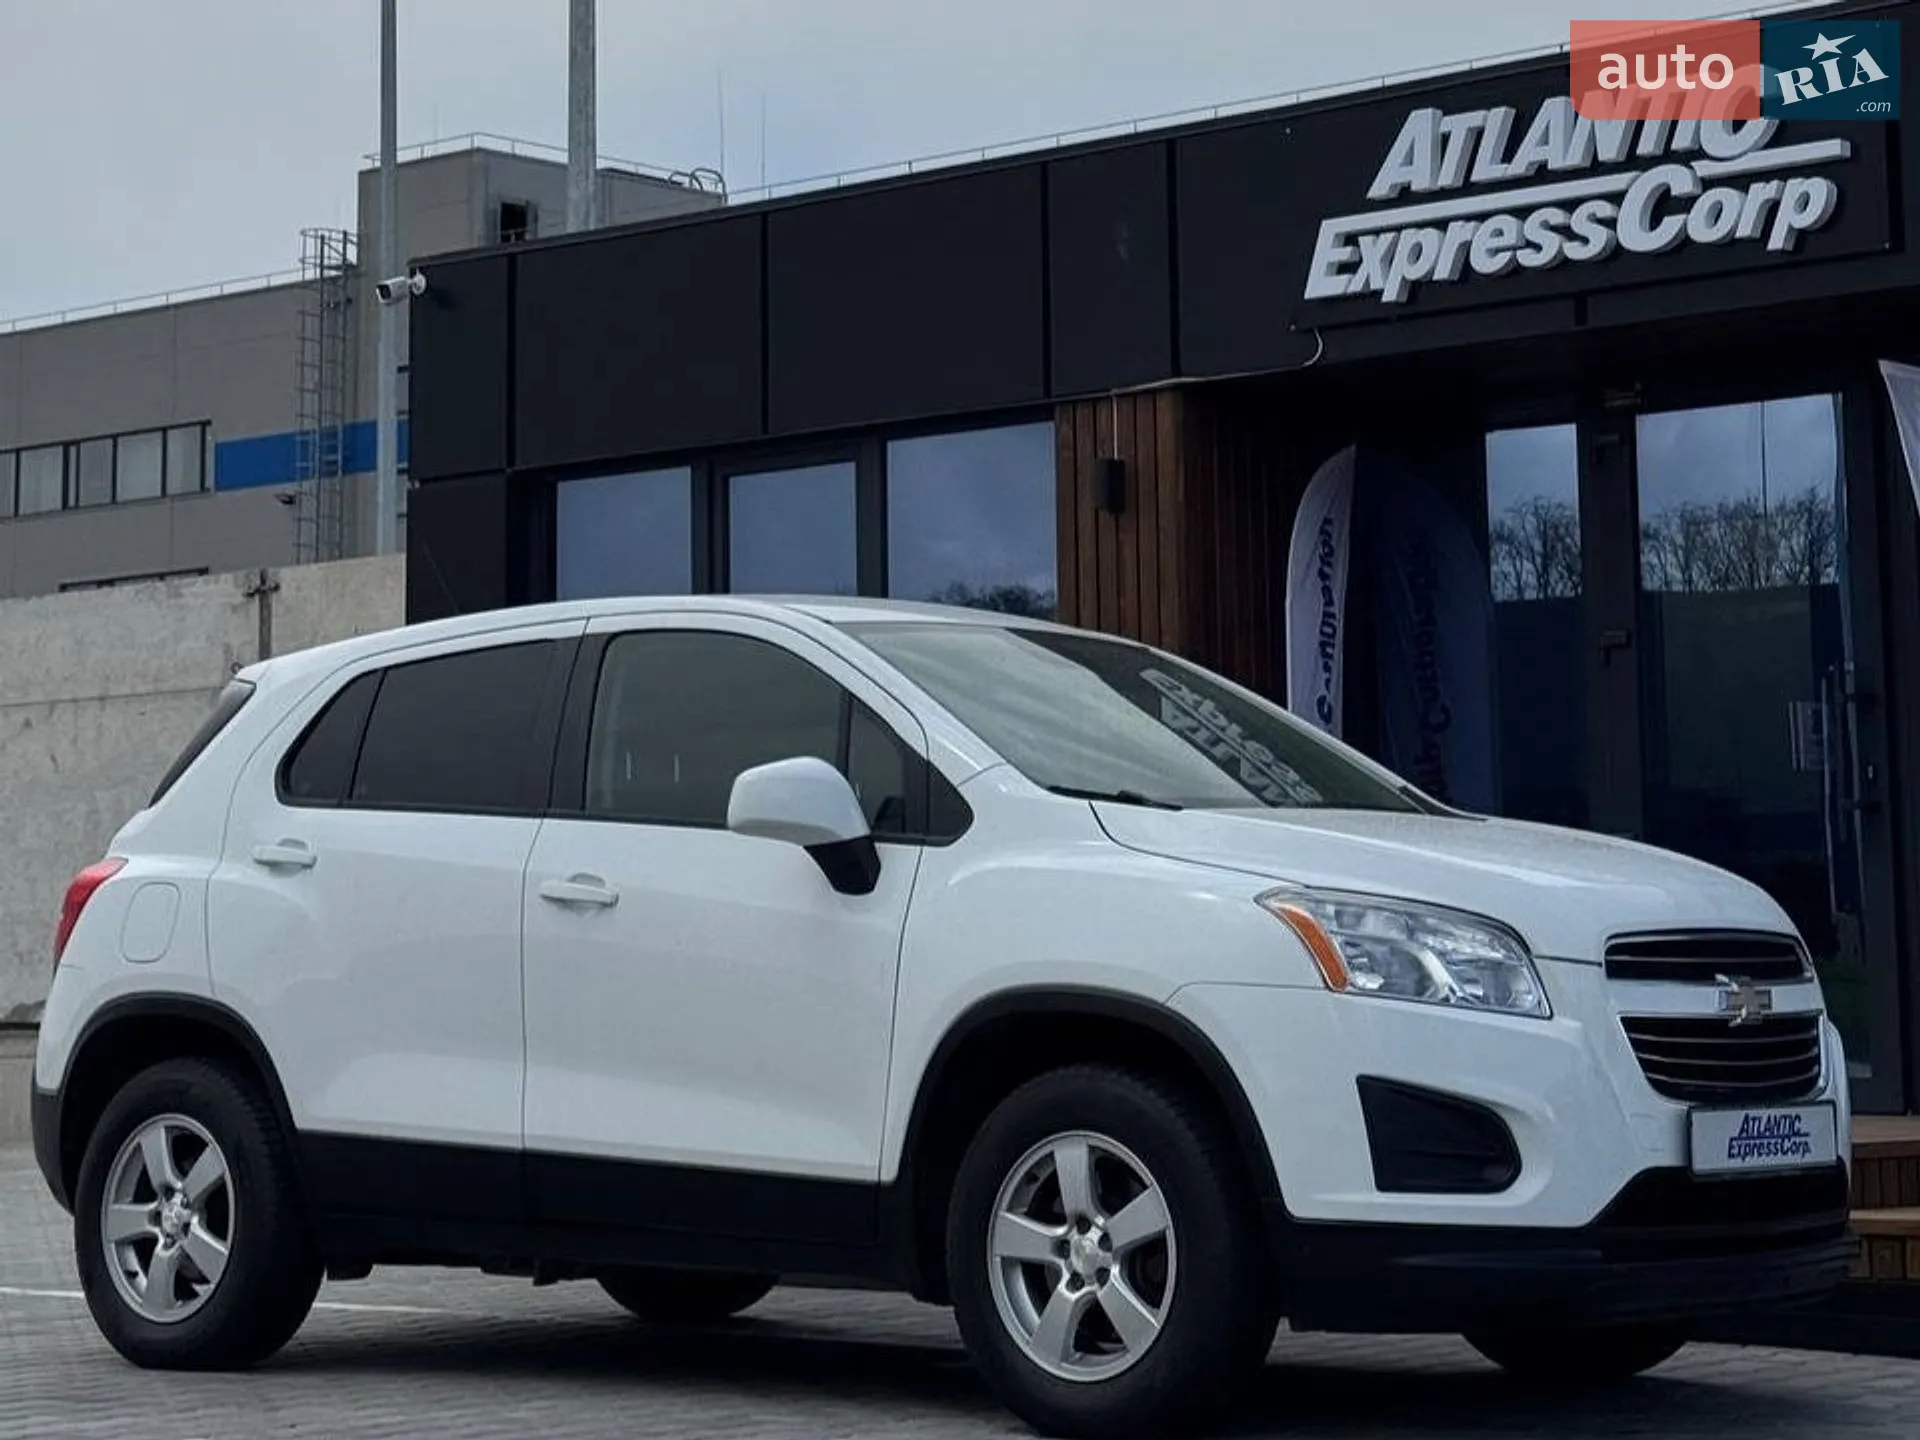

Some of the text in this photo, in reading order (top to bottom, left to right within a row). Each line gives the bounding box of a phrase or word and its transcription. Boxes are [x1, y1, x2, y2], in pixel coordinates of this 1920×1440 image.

[1366, 65, 1784, 199] ATLANTIC
[1305, 164, 1836, 302] ExpressCorp
[1738, 1113, 1802, 1137] ATLANTIC
